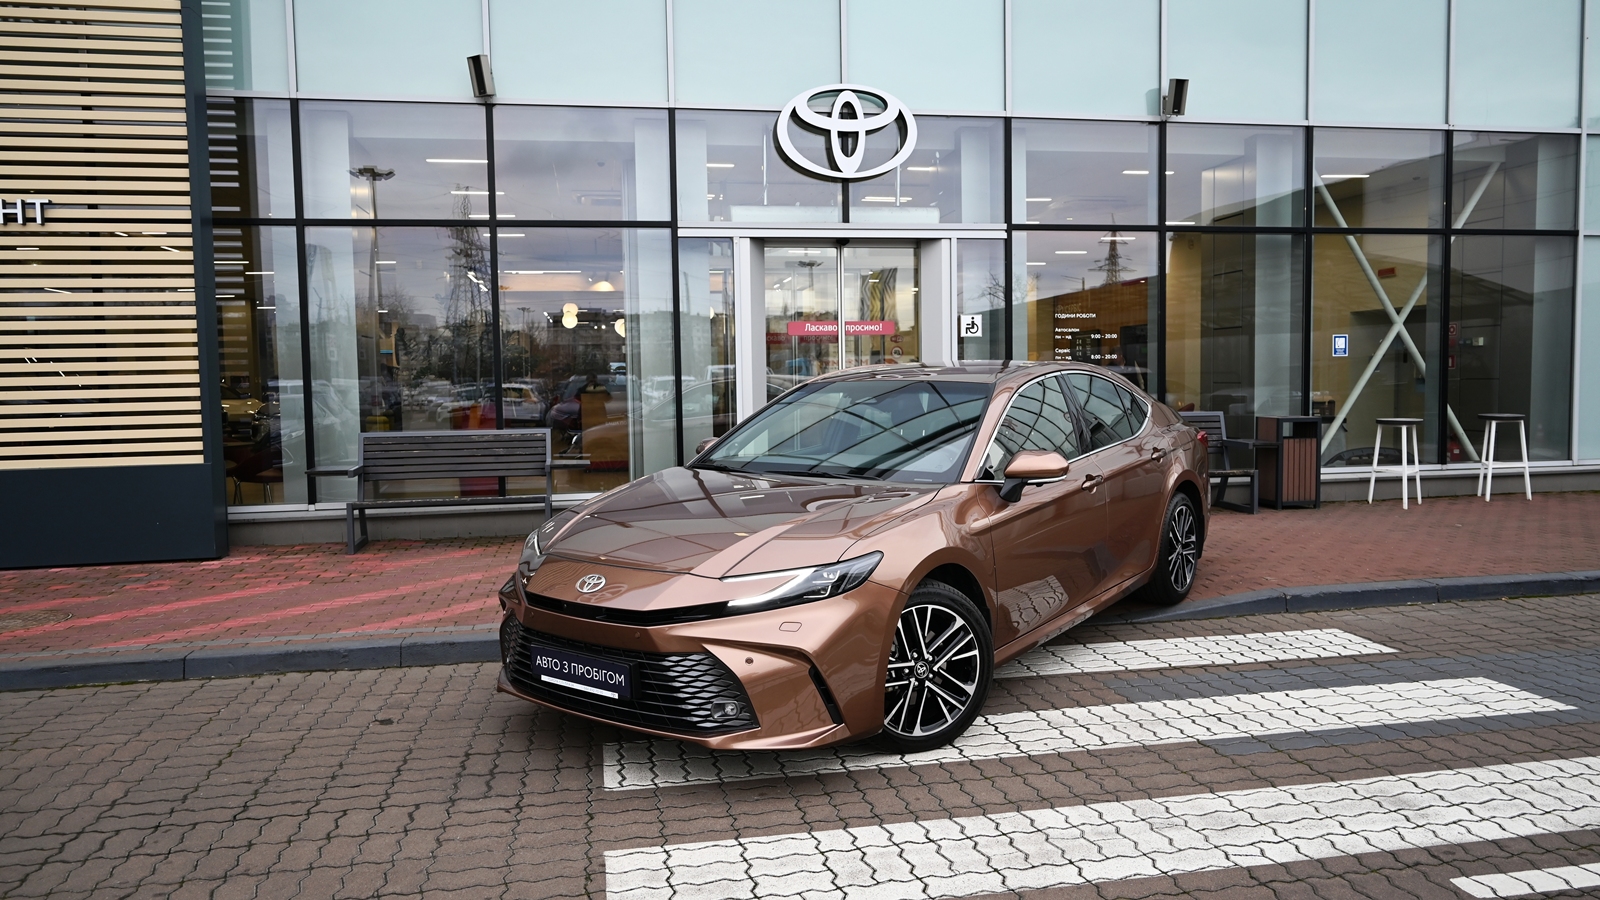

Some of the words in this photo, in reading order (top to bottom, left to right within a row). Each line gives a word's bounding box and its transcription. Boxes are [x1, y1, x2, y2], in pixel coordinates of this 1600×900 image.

[805, 323, 838, 332] Ласкаво
[845, 323, 883, 334] просимо!
[535, 655, 560, 671] АВТО
[571, 663, 625, 686] ПРОБІГОМ
